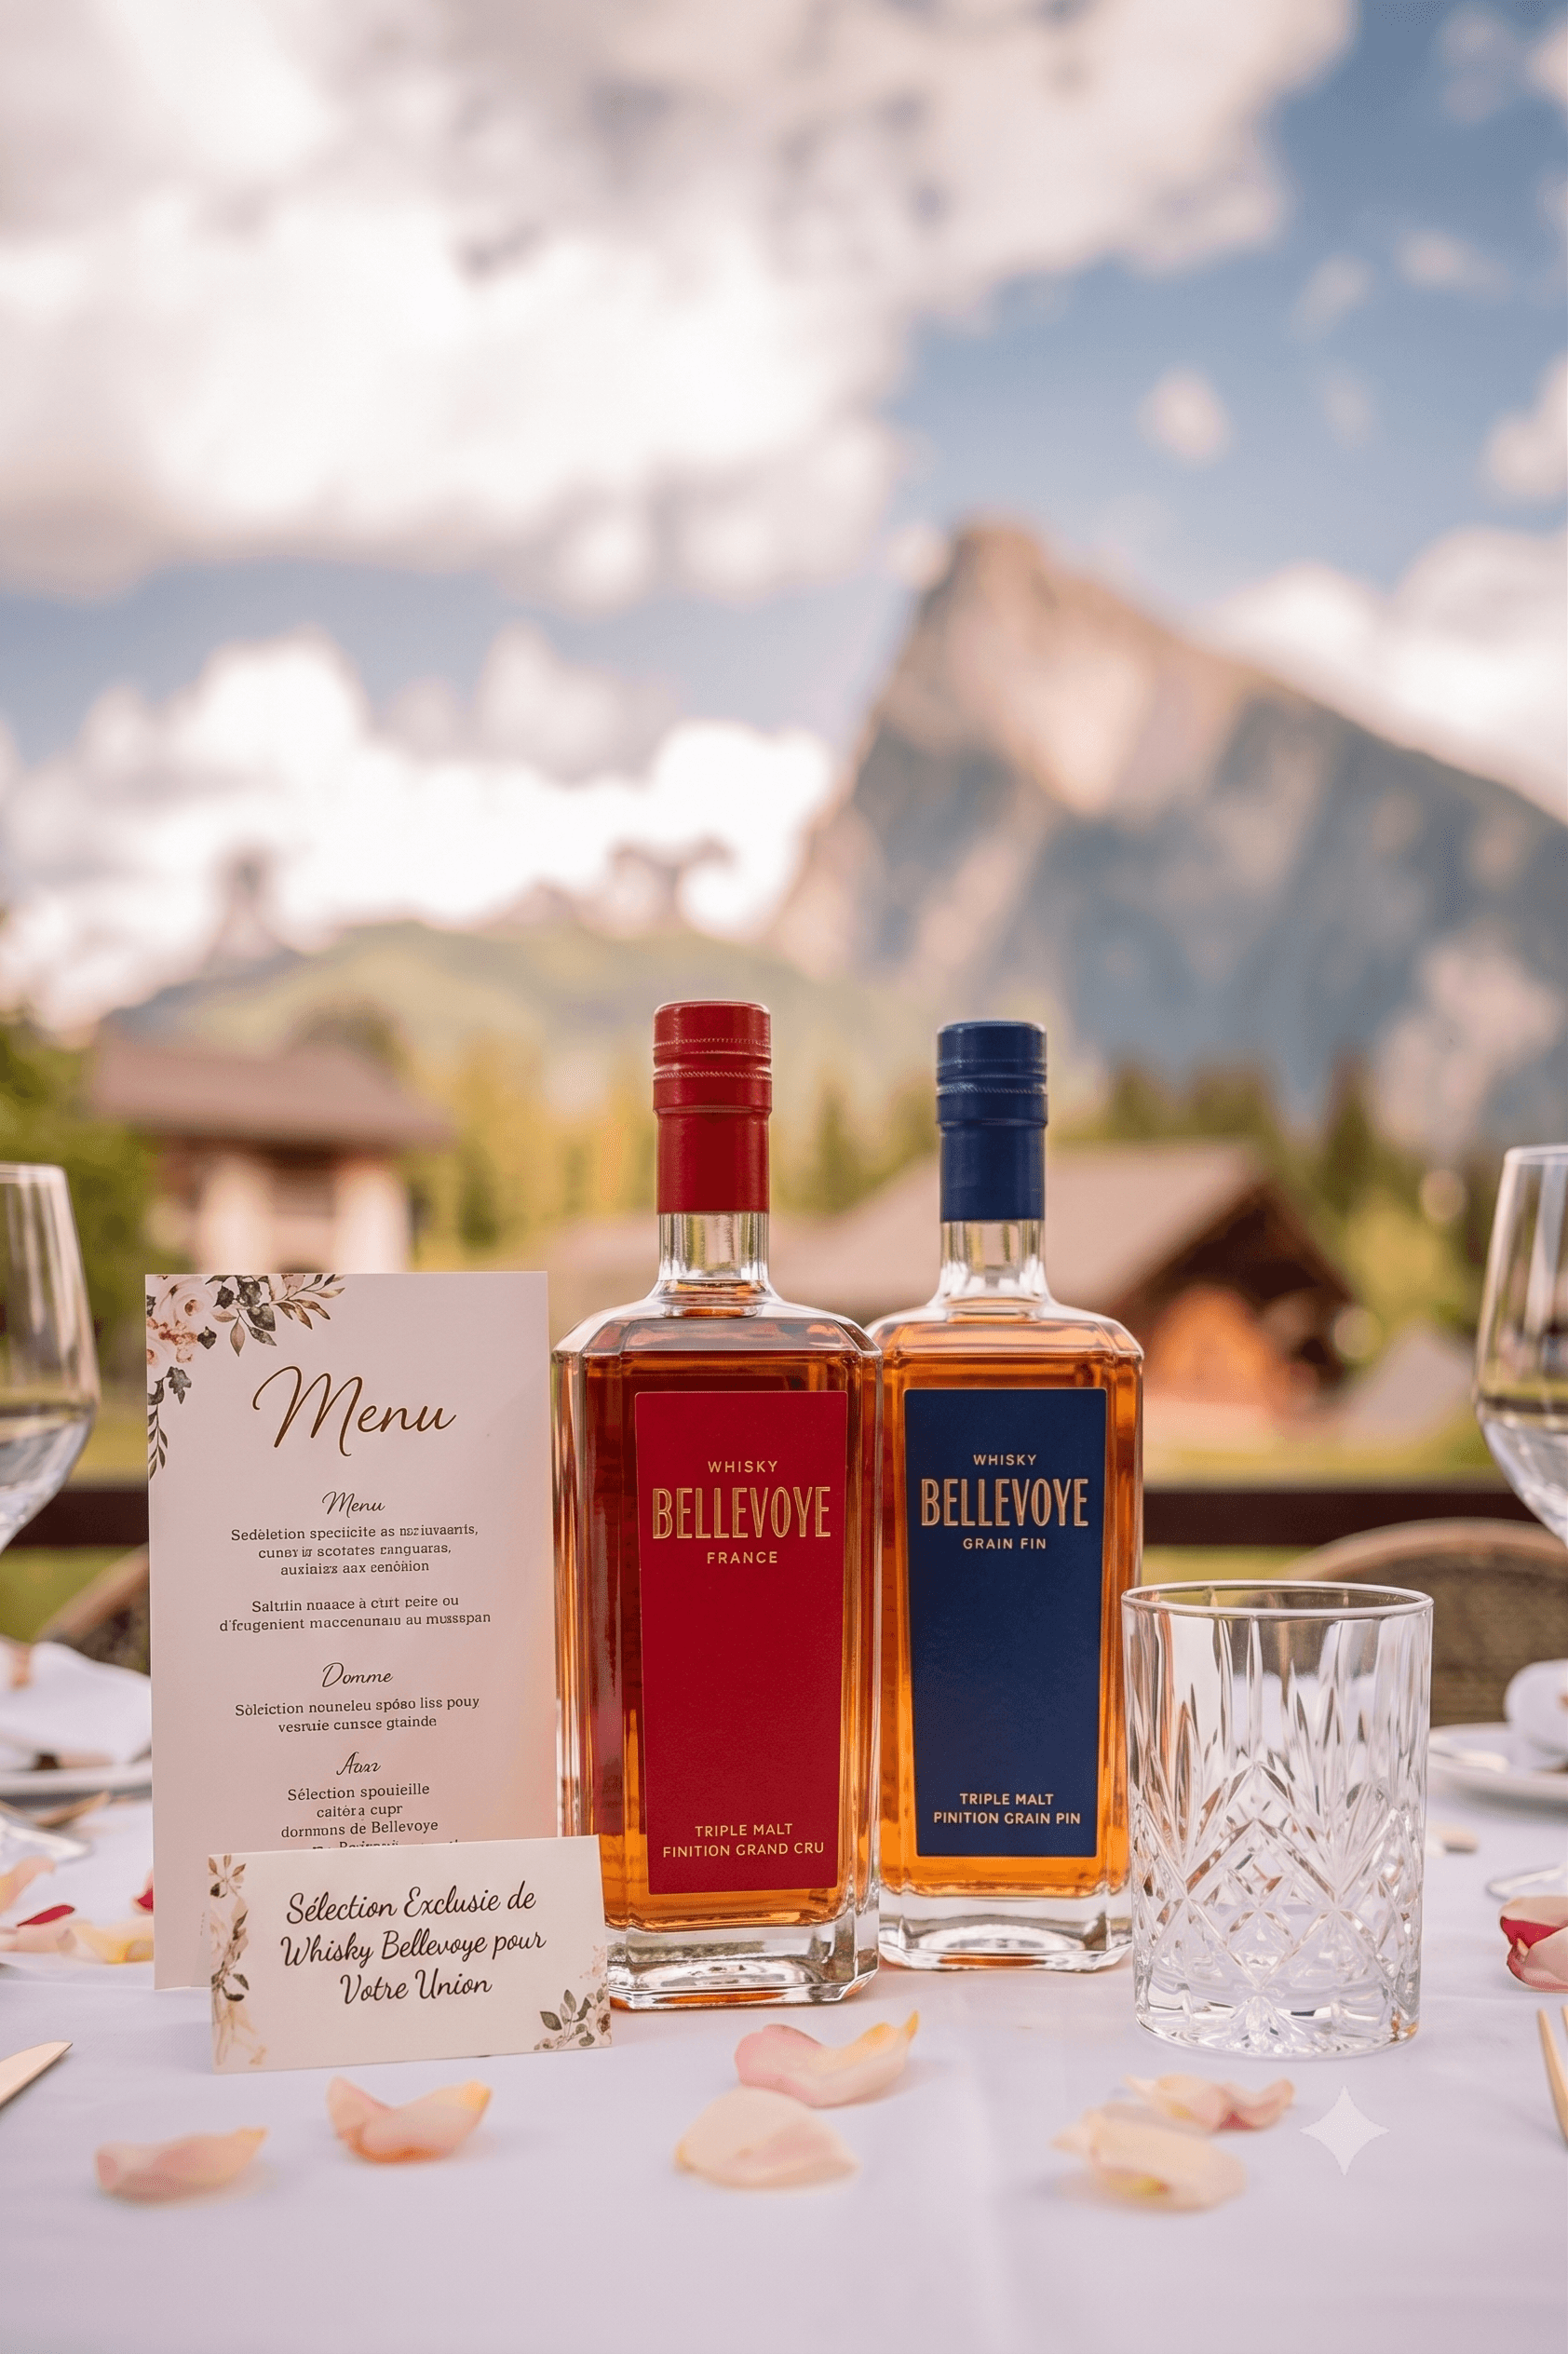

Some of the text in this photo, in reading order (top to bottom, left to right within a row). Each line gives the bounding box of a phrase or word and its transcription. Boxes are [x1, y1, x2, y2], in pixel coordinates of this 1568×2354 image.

[251, 1365, 457, 1457] Menu
[708, 1460, 778, 1473] WHISKY
[972, 1454, 1037, 1467] WHISKY
[321, 1491, 385, 1519] Menu
[921, 1478, 1089, 1527] BELLEVOYE
[652, 1486, 831, 1539] BELLEVOYE
[380, 1528, 396, 1537] as
[963, 1537, 1047, 1549] GRAIN FIN
[707, 1550, 777, 1564] FRANCE
[342, 1564, 367, 1574] aax
[358, 1597, 367, 1609] à
[442, 1597, 459, 1606] ou
[405, 1616, 422, 1626] au
[420, 1697, 443, 1709] liss
[386, 1715, 437, 1731] gtainde
[287, 1782, 430, 1802] Sélection spouieille
[959, 1793, 1054, 1806] TRIPLE MALT
[370, 1805, 403, 1818] cupr
[933, 1811, 1081, 1825] PINITION GRAIN PIN
[349, 1822, 367, 1835] de
[371, 1820, 439, 1834] Bellevoye
[694, 1822, 793, 1837] TRIPLE MALT
[663, 1841, 824, 1859] FINITION GRAND CRU
[286, 1880, 537, 1925] Sélection Exclusie de
[279, 1928, 547, 1969] Whisky Bellevoye pour
[339, 1968, 493, 2005] Votre Union
